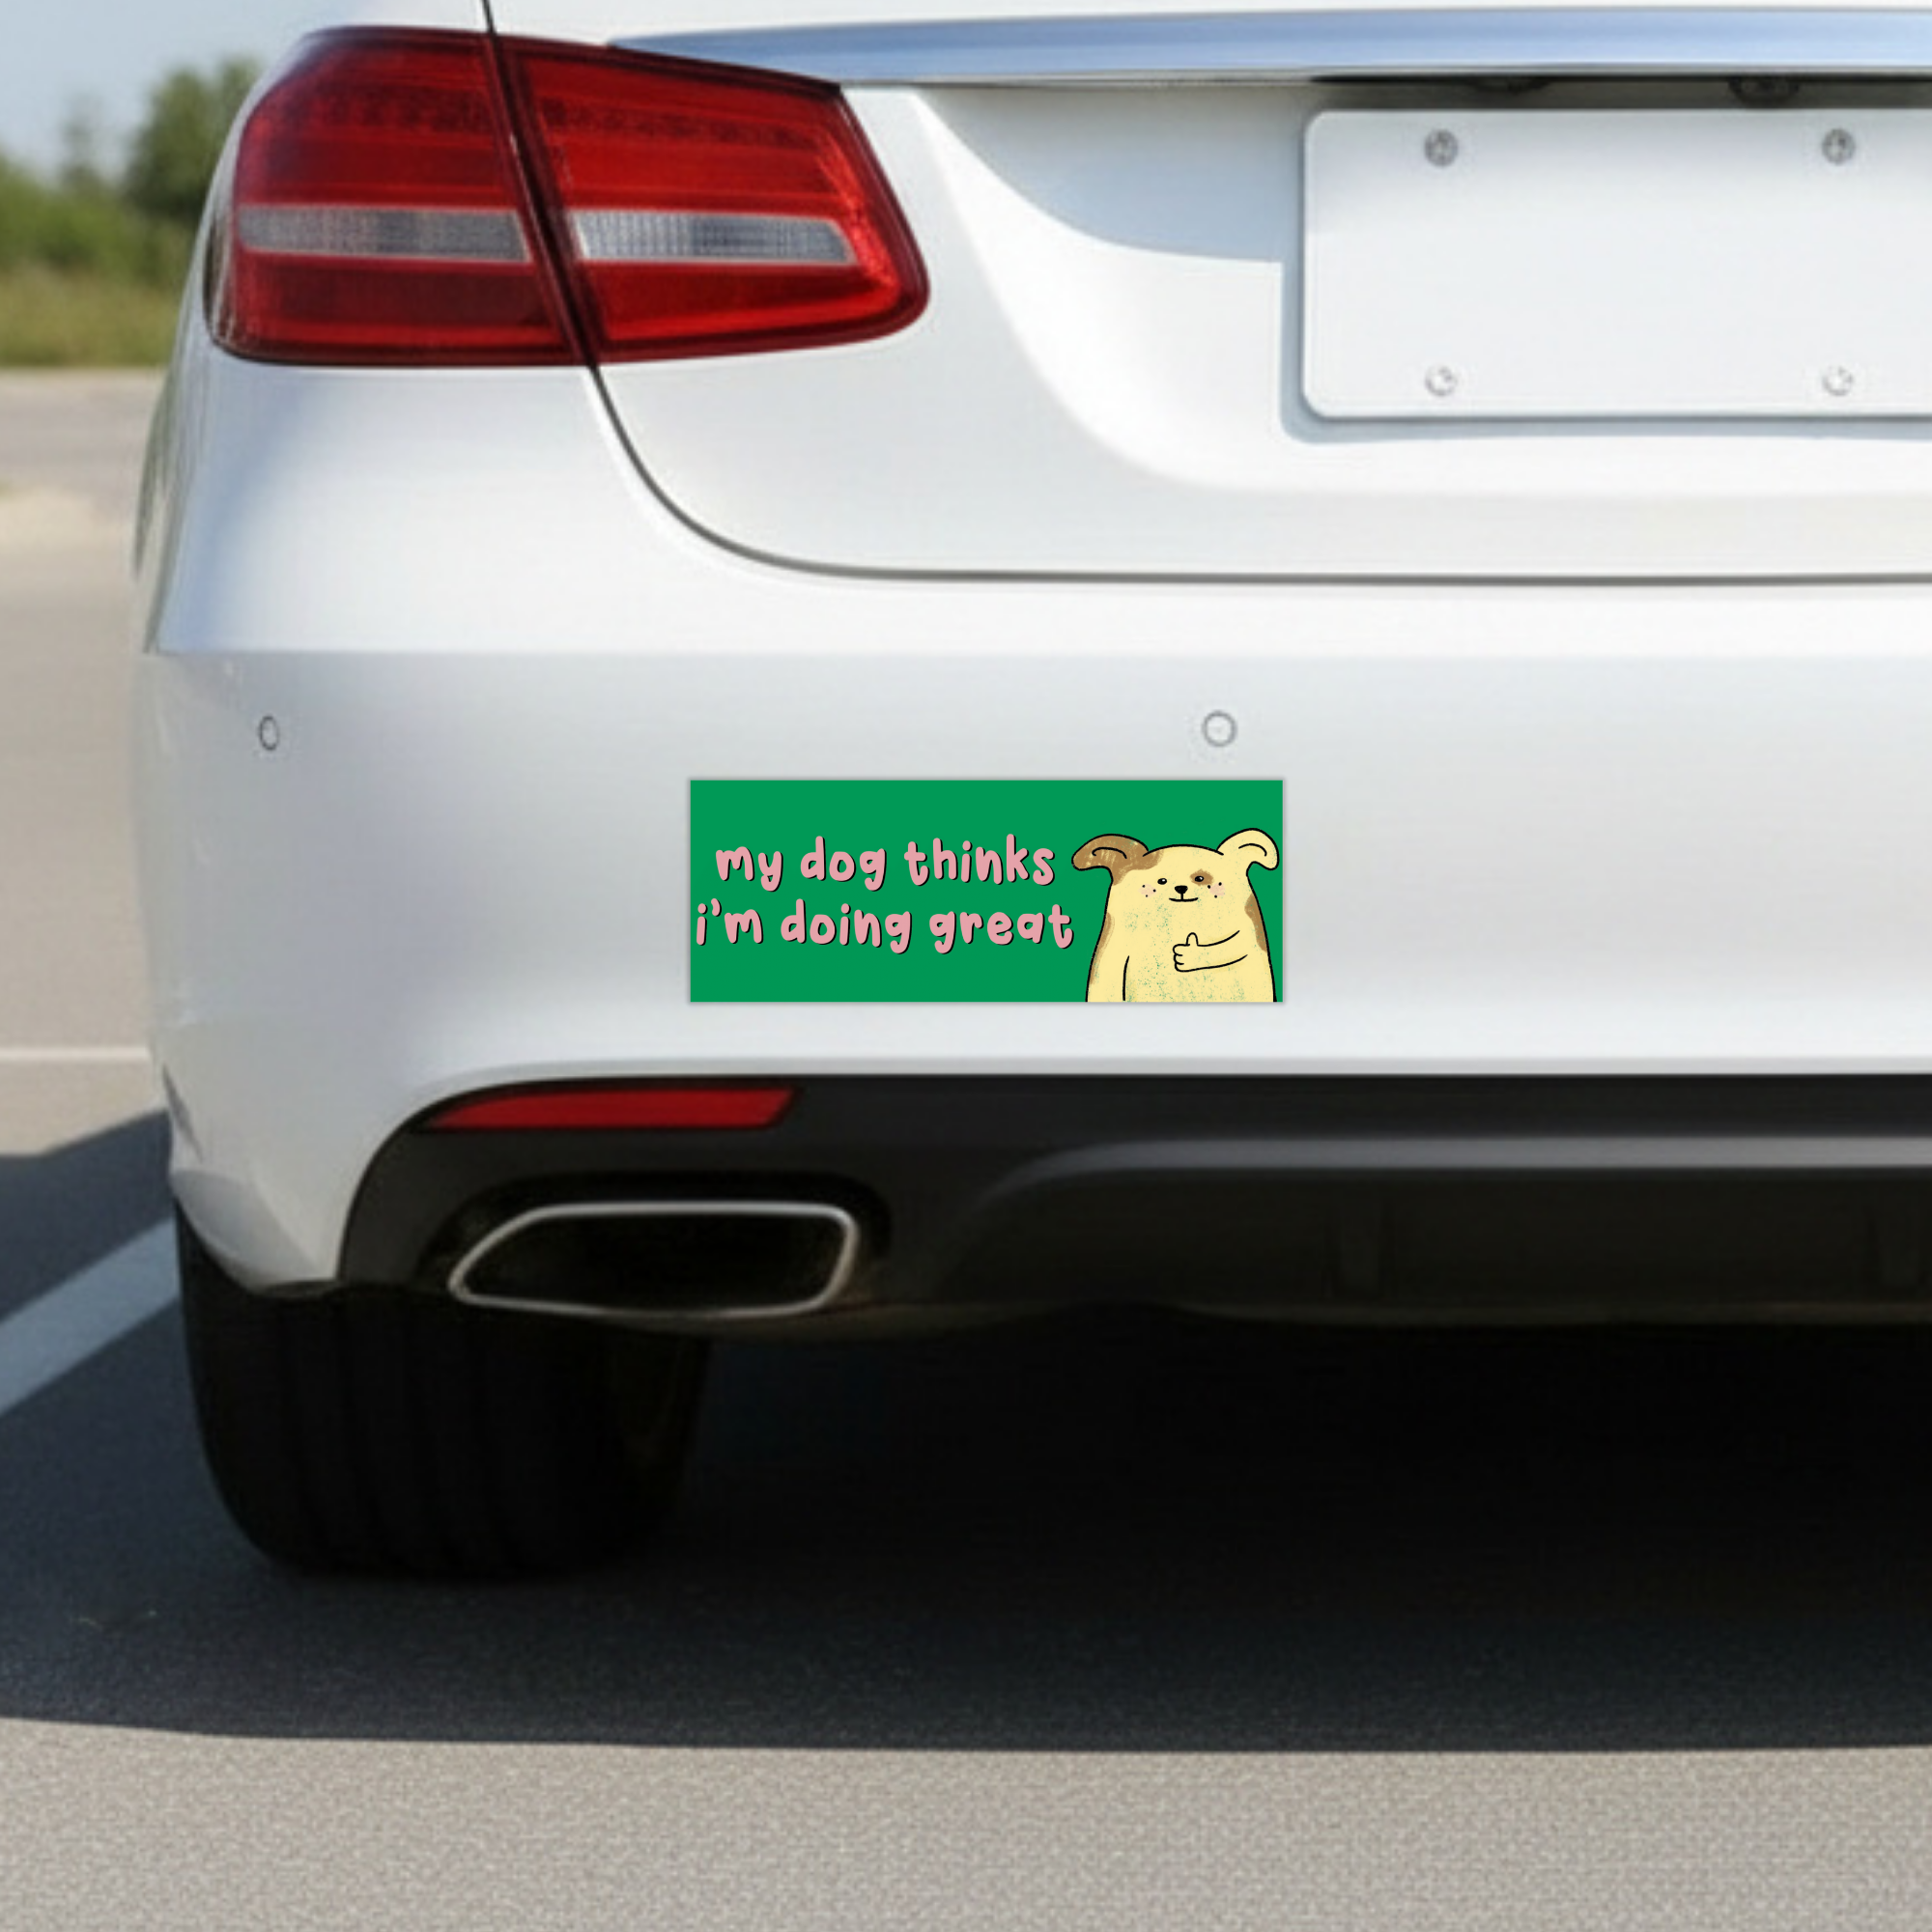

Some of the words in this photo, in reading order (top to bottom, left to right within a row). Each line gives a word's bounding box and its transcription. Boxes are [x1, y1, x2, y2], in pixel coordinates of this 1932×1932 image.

[715, 845, 784, 893] my
[800, 835, 888, 893] dog
[903, 833, 1056, 887] thinks
[696, 897, 765, 946] i'm
[780, 897, 913, 954] doing
[928, 903, 1075, 955] great
